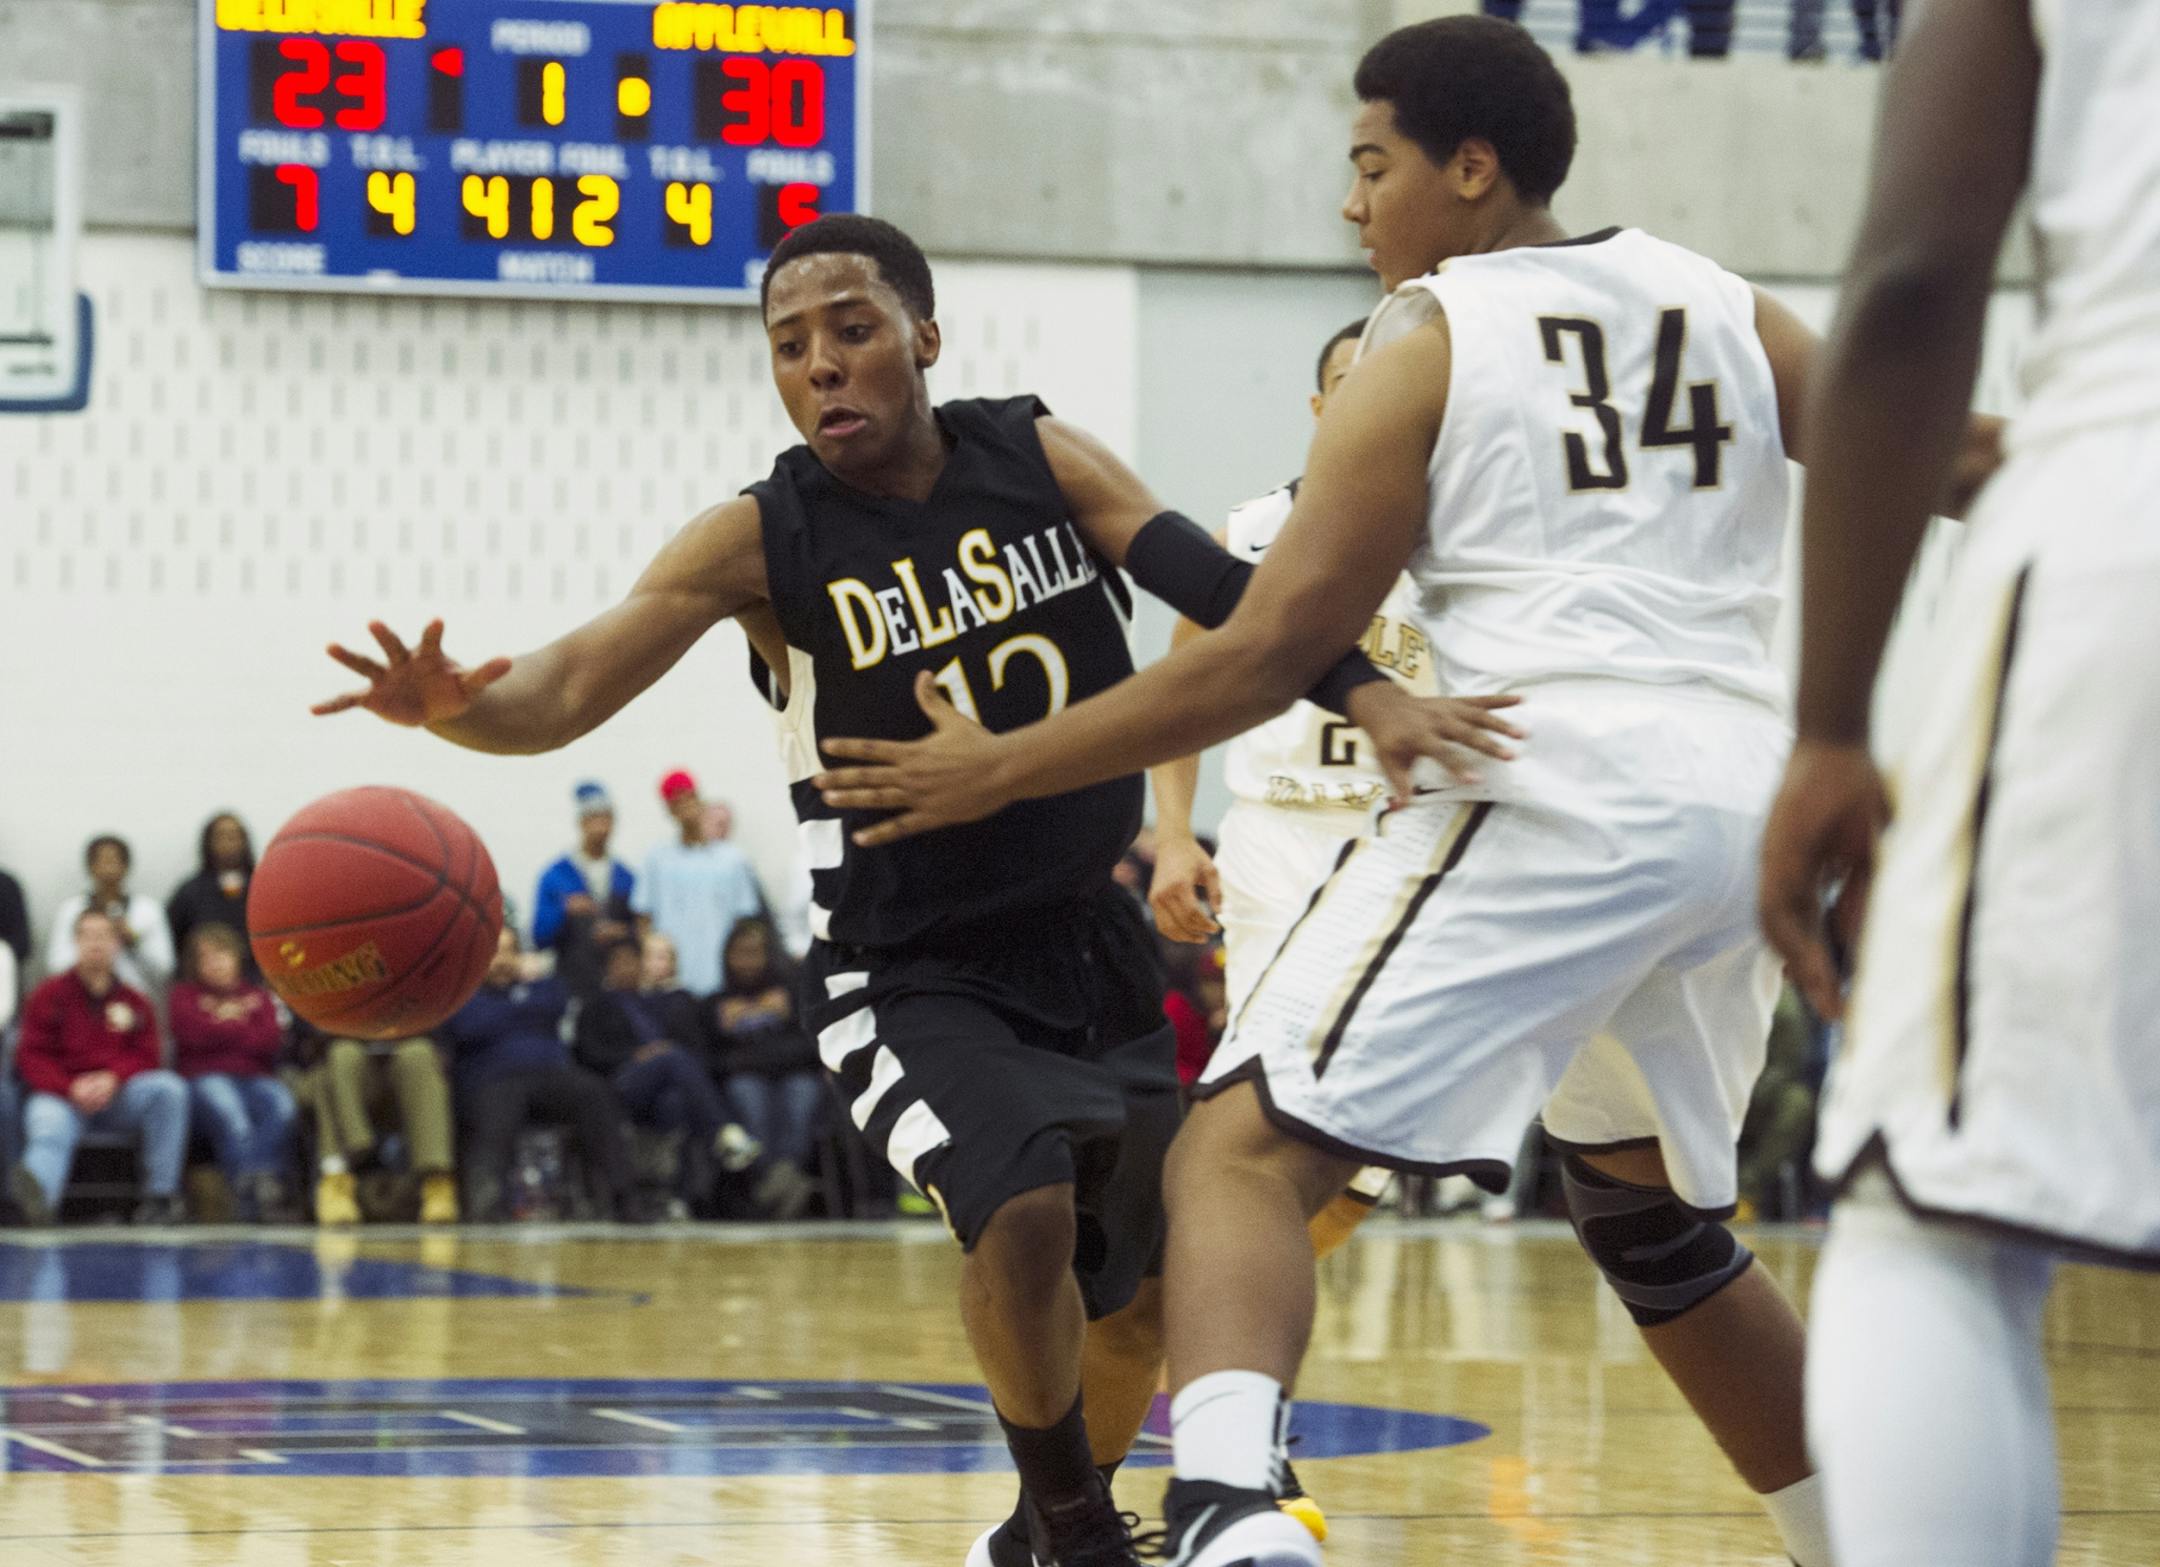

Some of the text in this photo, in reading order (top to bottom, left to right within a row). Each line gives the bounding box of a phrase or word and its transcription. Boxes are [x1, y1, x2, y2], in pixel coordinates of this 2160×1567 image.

[273, 38, 387, 131] 23
[542, 61, 566, 126] 1
[720, 56, 826, 148] 30
[275, 162, 318, 232] 7
[367, 170, 416, 236] 4
[665, 181, 713, 247] 4
[1535, 304, 1737, 495] 34
